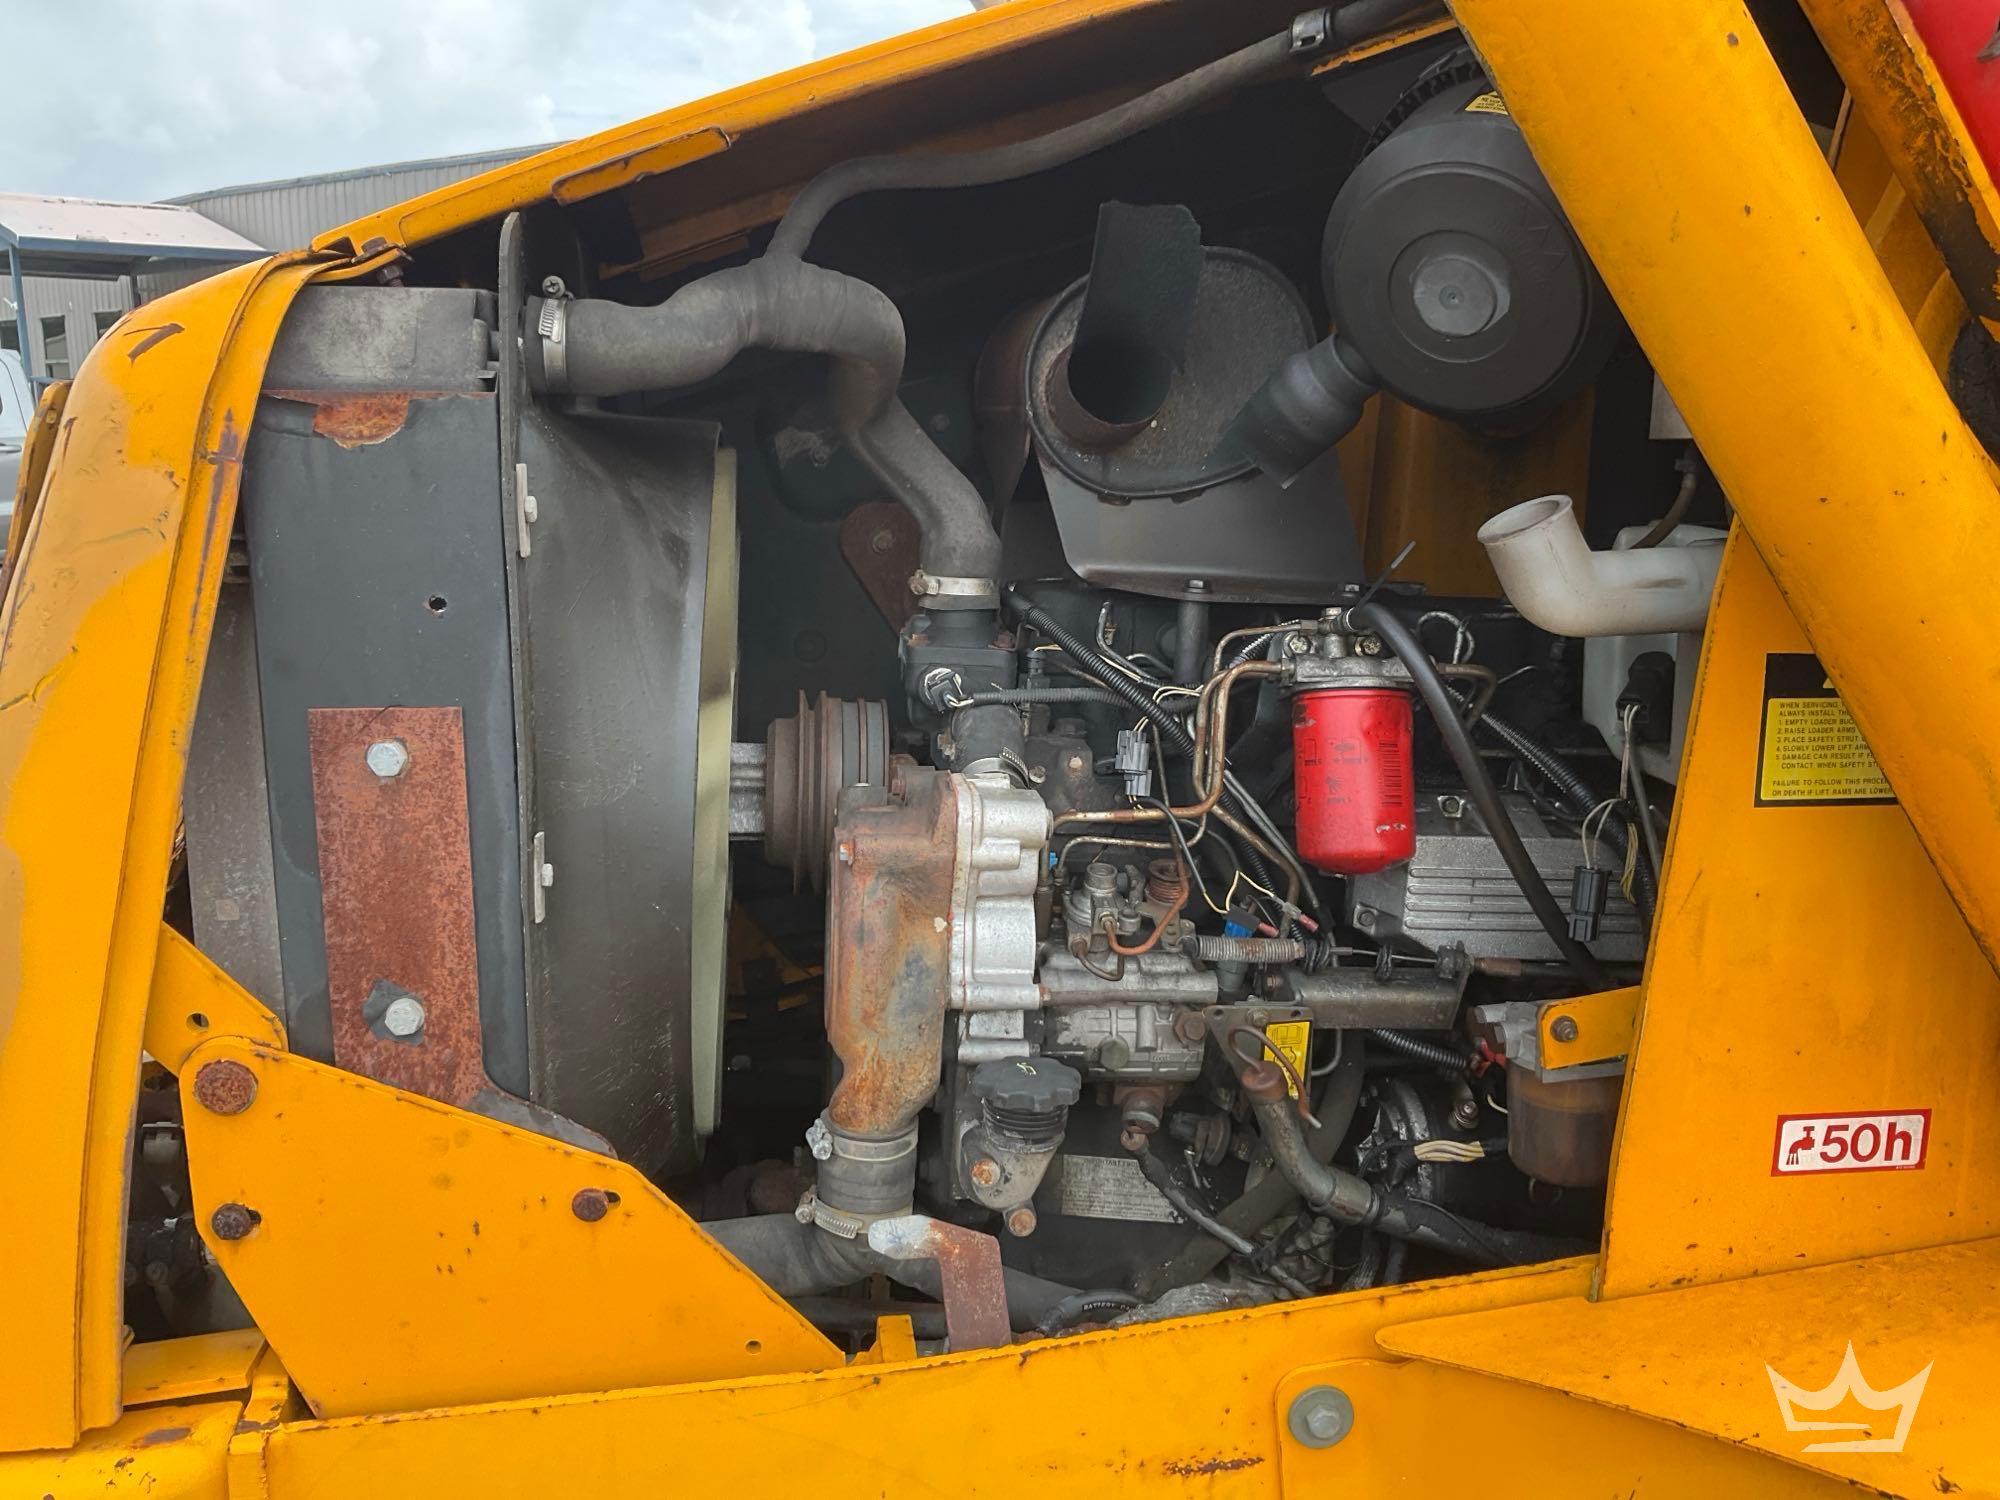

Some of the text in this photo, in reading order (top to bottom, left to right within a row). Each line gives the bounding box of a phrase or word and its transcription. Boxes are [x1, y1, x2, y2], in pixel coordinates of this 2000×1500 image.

[1782, 753, 1810, 761] DAMAGE
[1772, 779, 1800, 787] FAILURE
[1814, 778, 1842, 786] FOLLOW
[1772, 789, 1782, 797] OR
[1784, 789, 1805, 797] DEATH
[1820, 1121, 1913, 1164] 50h
